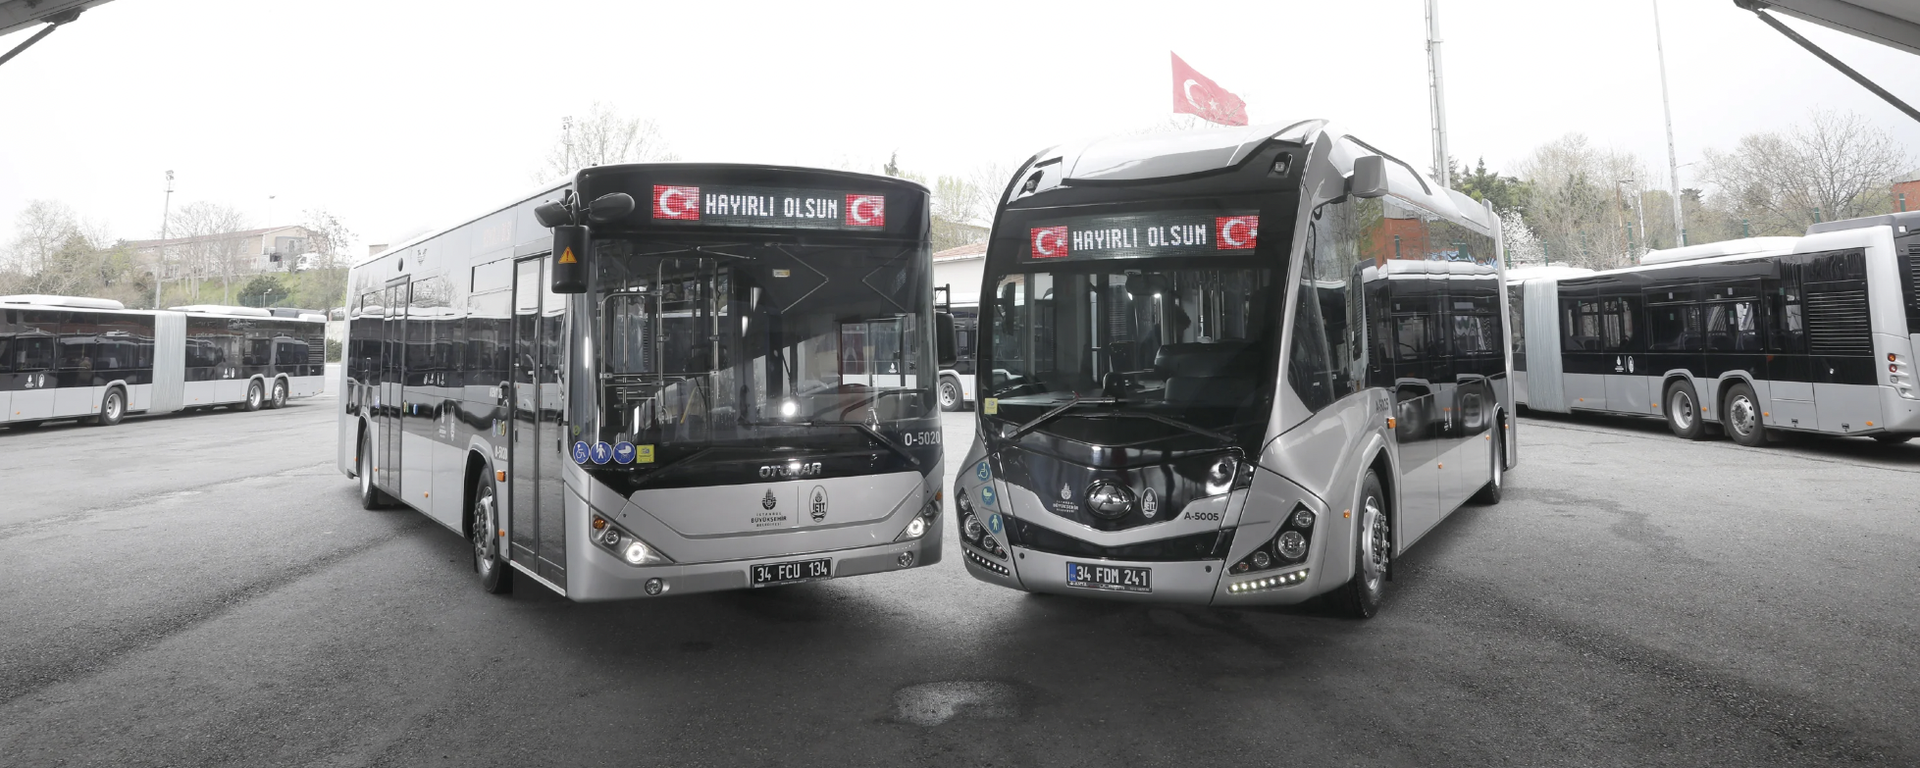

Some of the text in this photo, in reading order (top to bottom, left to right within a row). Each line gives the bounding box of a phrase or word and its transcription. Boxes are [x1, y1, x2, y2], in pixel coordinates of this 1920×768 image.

[705, 193, 838, 219] HAYIRLI OLSUN
[1072, 224, 1207, 251] HAYIRLI OLSUN
[758, 462, 822, 478] OTOKAR
[1183, 512, 1219, 521] A-5005
[757, 561, 828, 582] 34 FCU 134
[1076, 565, 1092, 582] 34
[1096, 567, 1119, 584] FDM
[1123, 569, 1147, 586] 241
